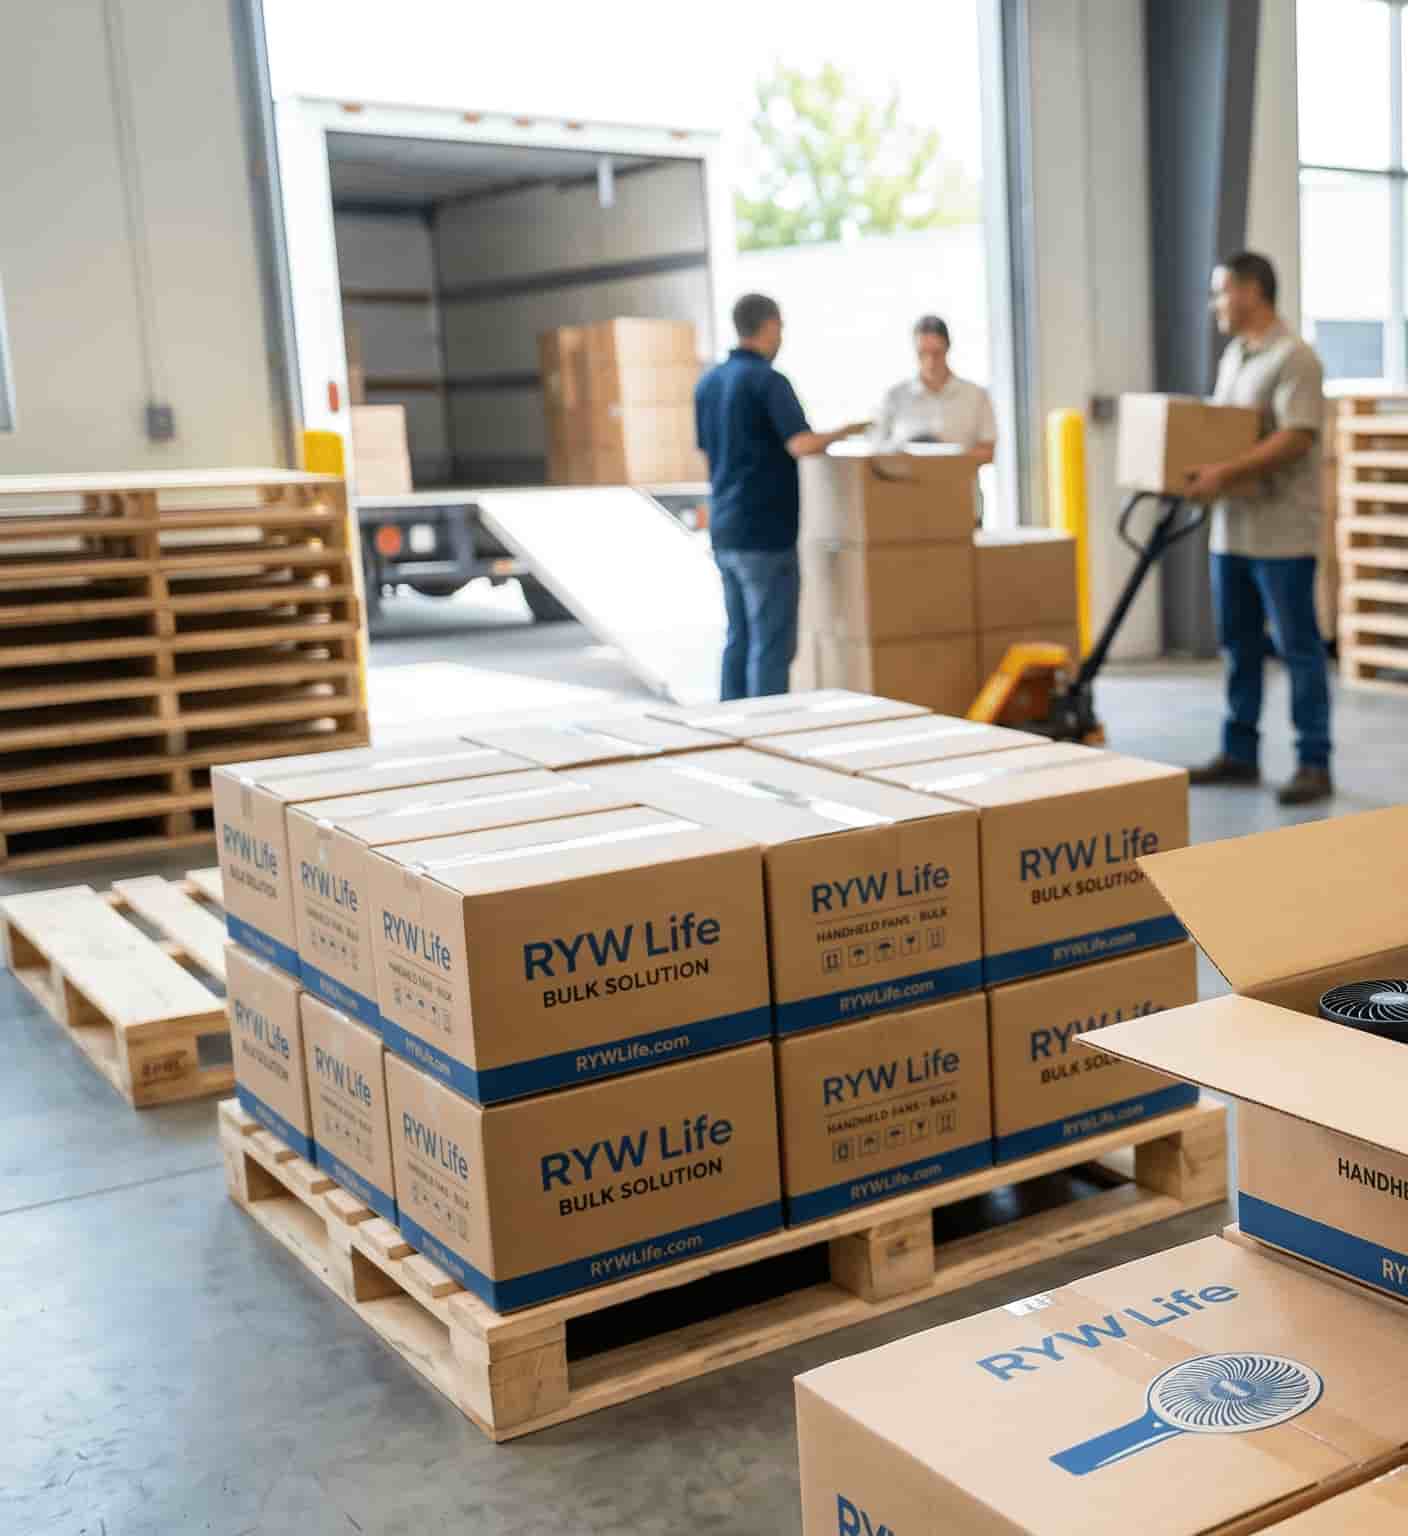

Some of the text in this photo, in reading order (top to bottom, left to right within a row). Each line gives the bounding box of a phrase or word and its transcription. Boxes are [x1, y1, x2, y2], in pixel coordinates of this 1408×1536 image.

[254, 838, 278, 876] Life
[1019, 826, 1159, 881] RYW Life
[300, 862, 358, 912] RYW Life
[811, 863, 949, 913] RYW Life
[1031, 880, 1072, 904] BULK
[383, 911, 418, 953] RYW
[422, 927, 451, 970] Life
[523, 912, 721, 982] RYW Life
[816, 920, 880, 944] HANDHELD
[881, 914, 911, 931] FANS
[543, 958, 710, 1008] BULK SOLUTION
[265, 1019, 290, 1060] Life
[575, 1034, 690, 1073] RYWLife.com
[315, 1045, 347, 1089] RYW
[348, 1066, 372, 1107] Life
[823, 1048, 959, 1105] RYW Life
[827, 1109, 889, 1136] HANDHELD
[891, 1100, 920, 1116] FANS
[402, 1112, 438, 1162] RYW
[440, 1135, 469, 1181] Life
[540, 1114, 733, 1192] RYW Life
[559, 1158, 722, 1217] BULK SOLUTION
[591, 1233, 703, 1278] RYWLife.com
[975, 1284, 1240, 1382] RYW Life
